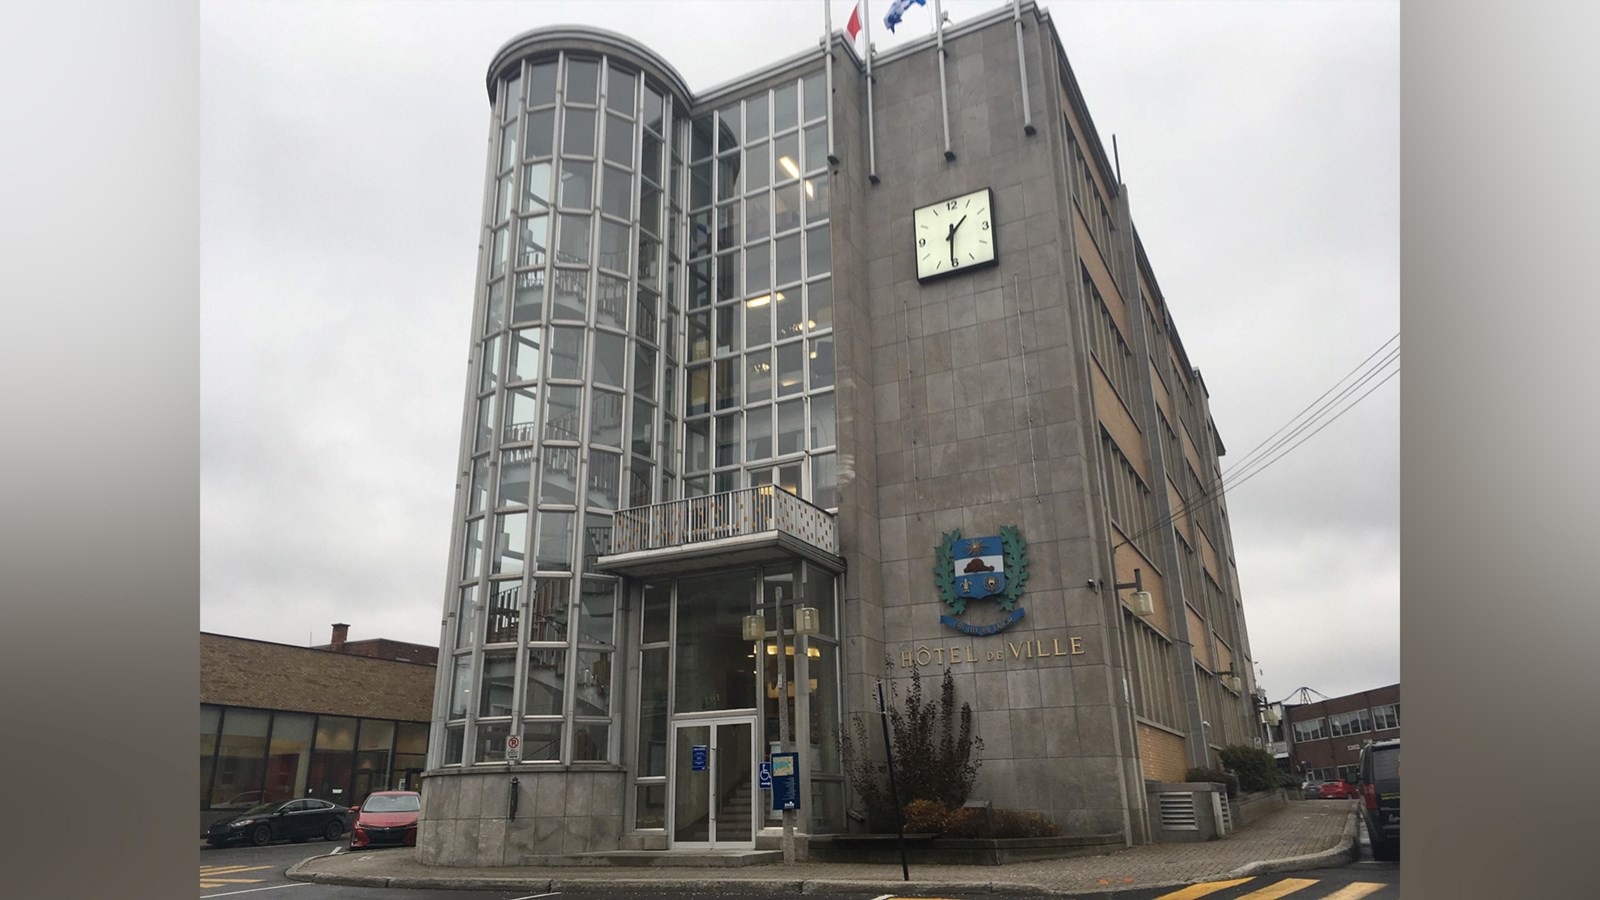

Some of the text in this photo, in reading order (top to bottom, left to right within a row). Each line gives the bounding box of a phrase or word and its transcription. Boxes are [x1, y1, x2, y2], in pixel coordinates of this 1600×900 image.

[946, 200, 957, 211] 12
[982, 220, 989, 230] 3
[919, 238, 926, 247] 9
[952, 258, 959, 267] 6
[900, 636, 1085, 668] HÔTEL DE VILLE
